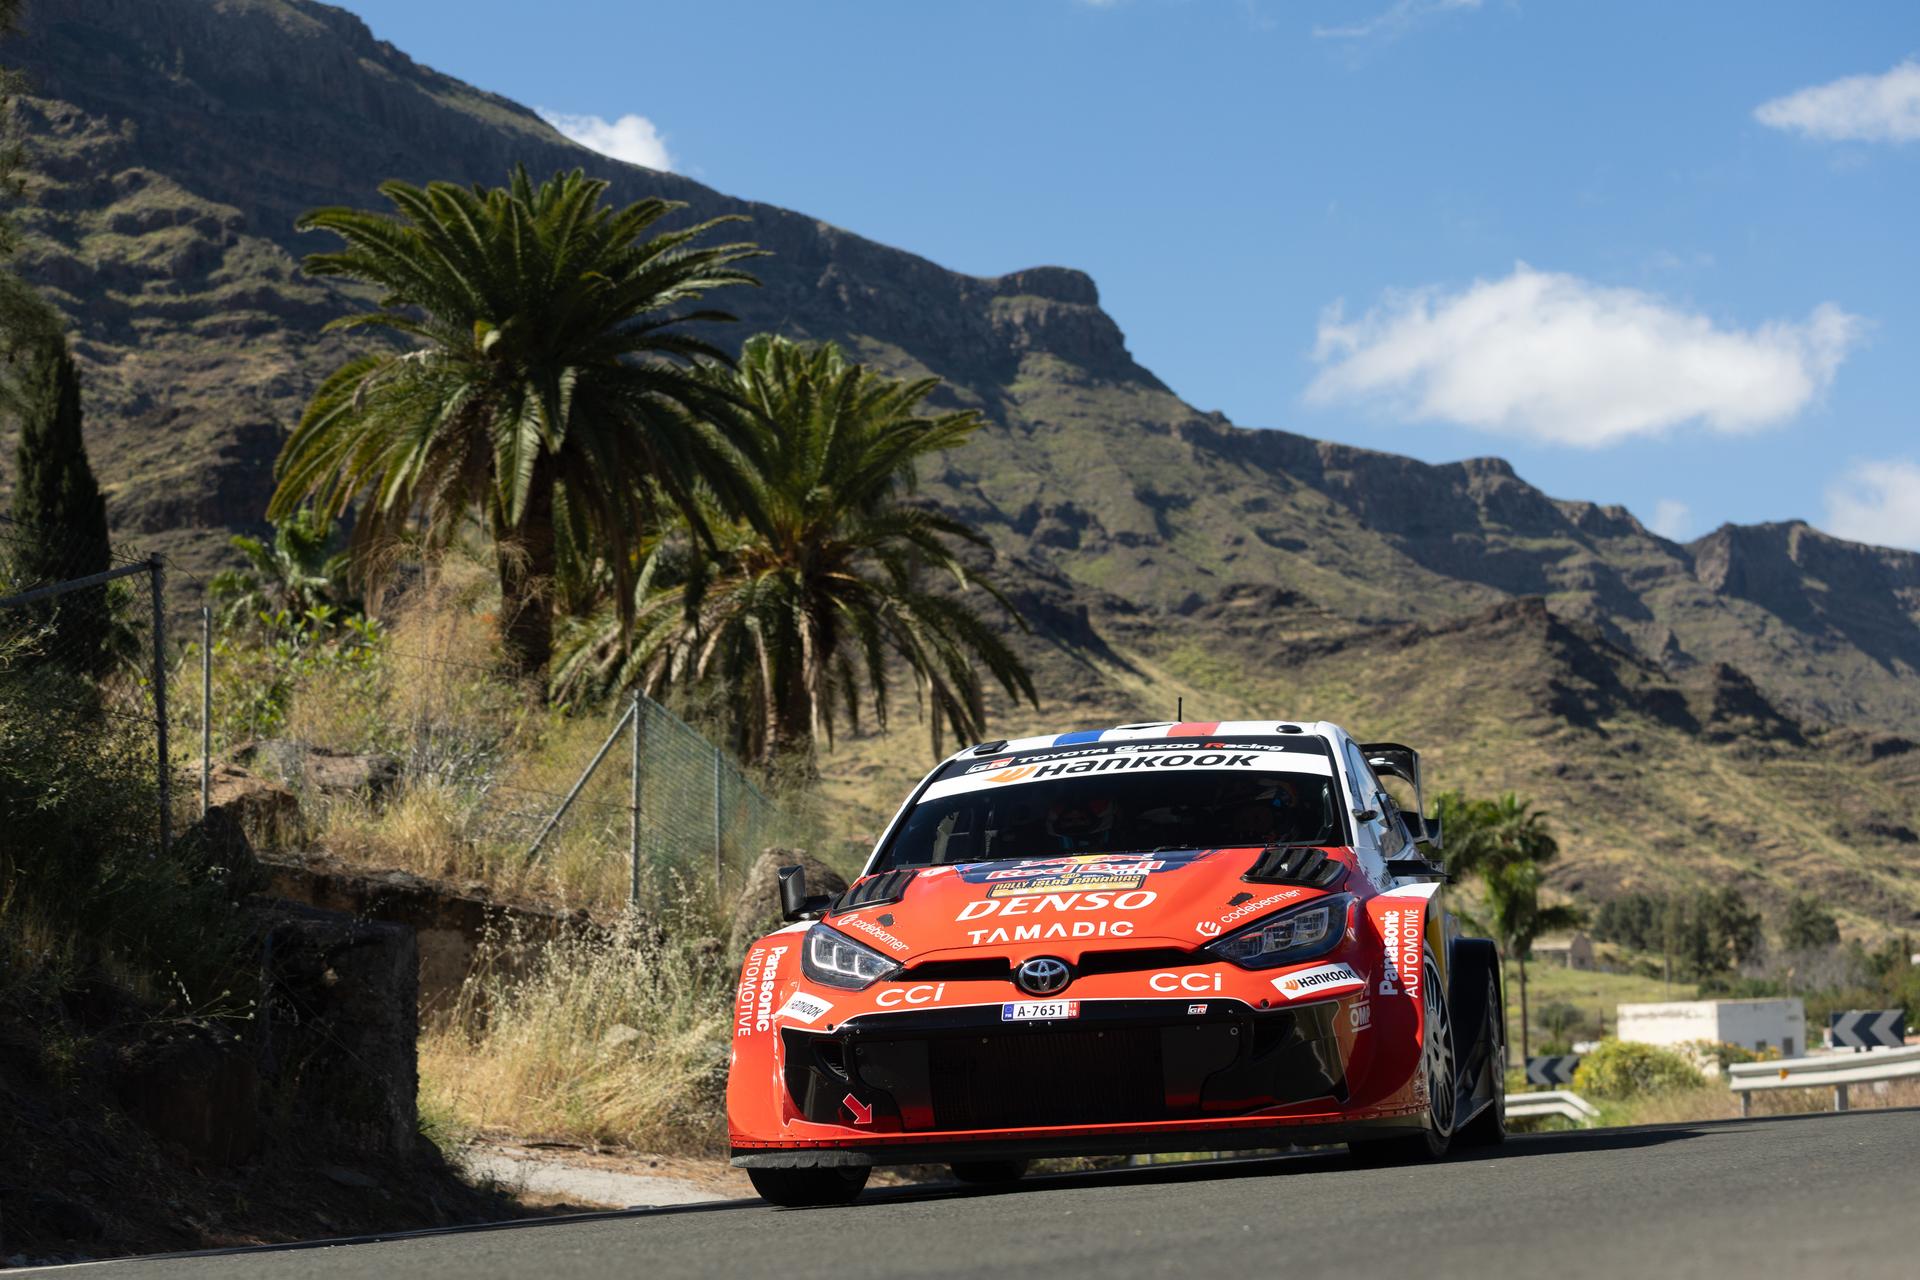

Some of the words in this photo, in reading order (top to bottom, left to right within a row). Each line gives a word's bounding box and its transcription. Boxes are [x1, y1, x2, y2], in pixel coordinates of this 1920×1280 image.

[1018, 748, 1108, 763] TOYOTA
[1114, 743, 1200, 754] GAZOO
[1204, 742, 1285, 752] Racing
[985, 864, 1078, 880] Red
[1076, 860, 1167, 873] Bull
[994, 881, 1029, 891] RALLY
[1031, 877, 1069, 887] ISLAS
[1072, 874, 1142, 884] CANARIAS
[955, 891, 1158, 922] DENSO
[1220, 889, 1302, 923] codebeamer
[852, 919, 910, 952] codebeamer
[967, 920, 1134, 945] TAMADIC
[1378, 910, 1400, 996] Panasonic
[1403, 909, 1420, 999] AUTOMOTIVE
[737, 948, 766, 1037] AUTOMOTIVE
[755, 946, 789, 1032] Panasonic
[1017, 1005, 1064, 1017] A-7651
[1188, 1004, 1207, 1014] GR
[1350, 1005, 1371, 1027] OMP
